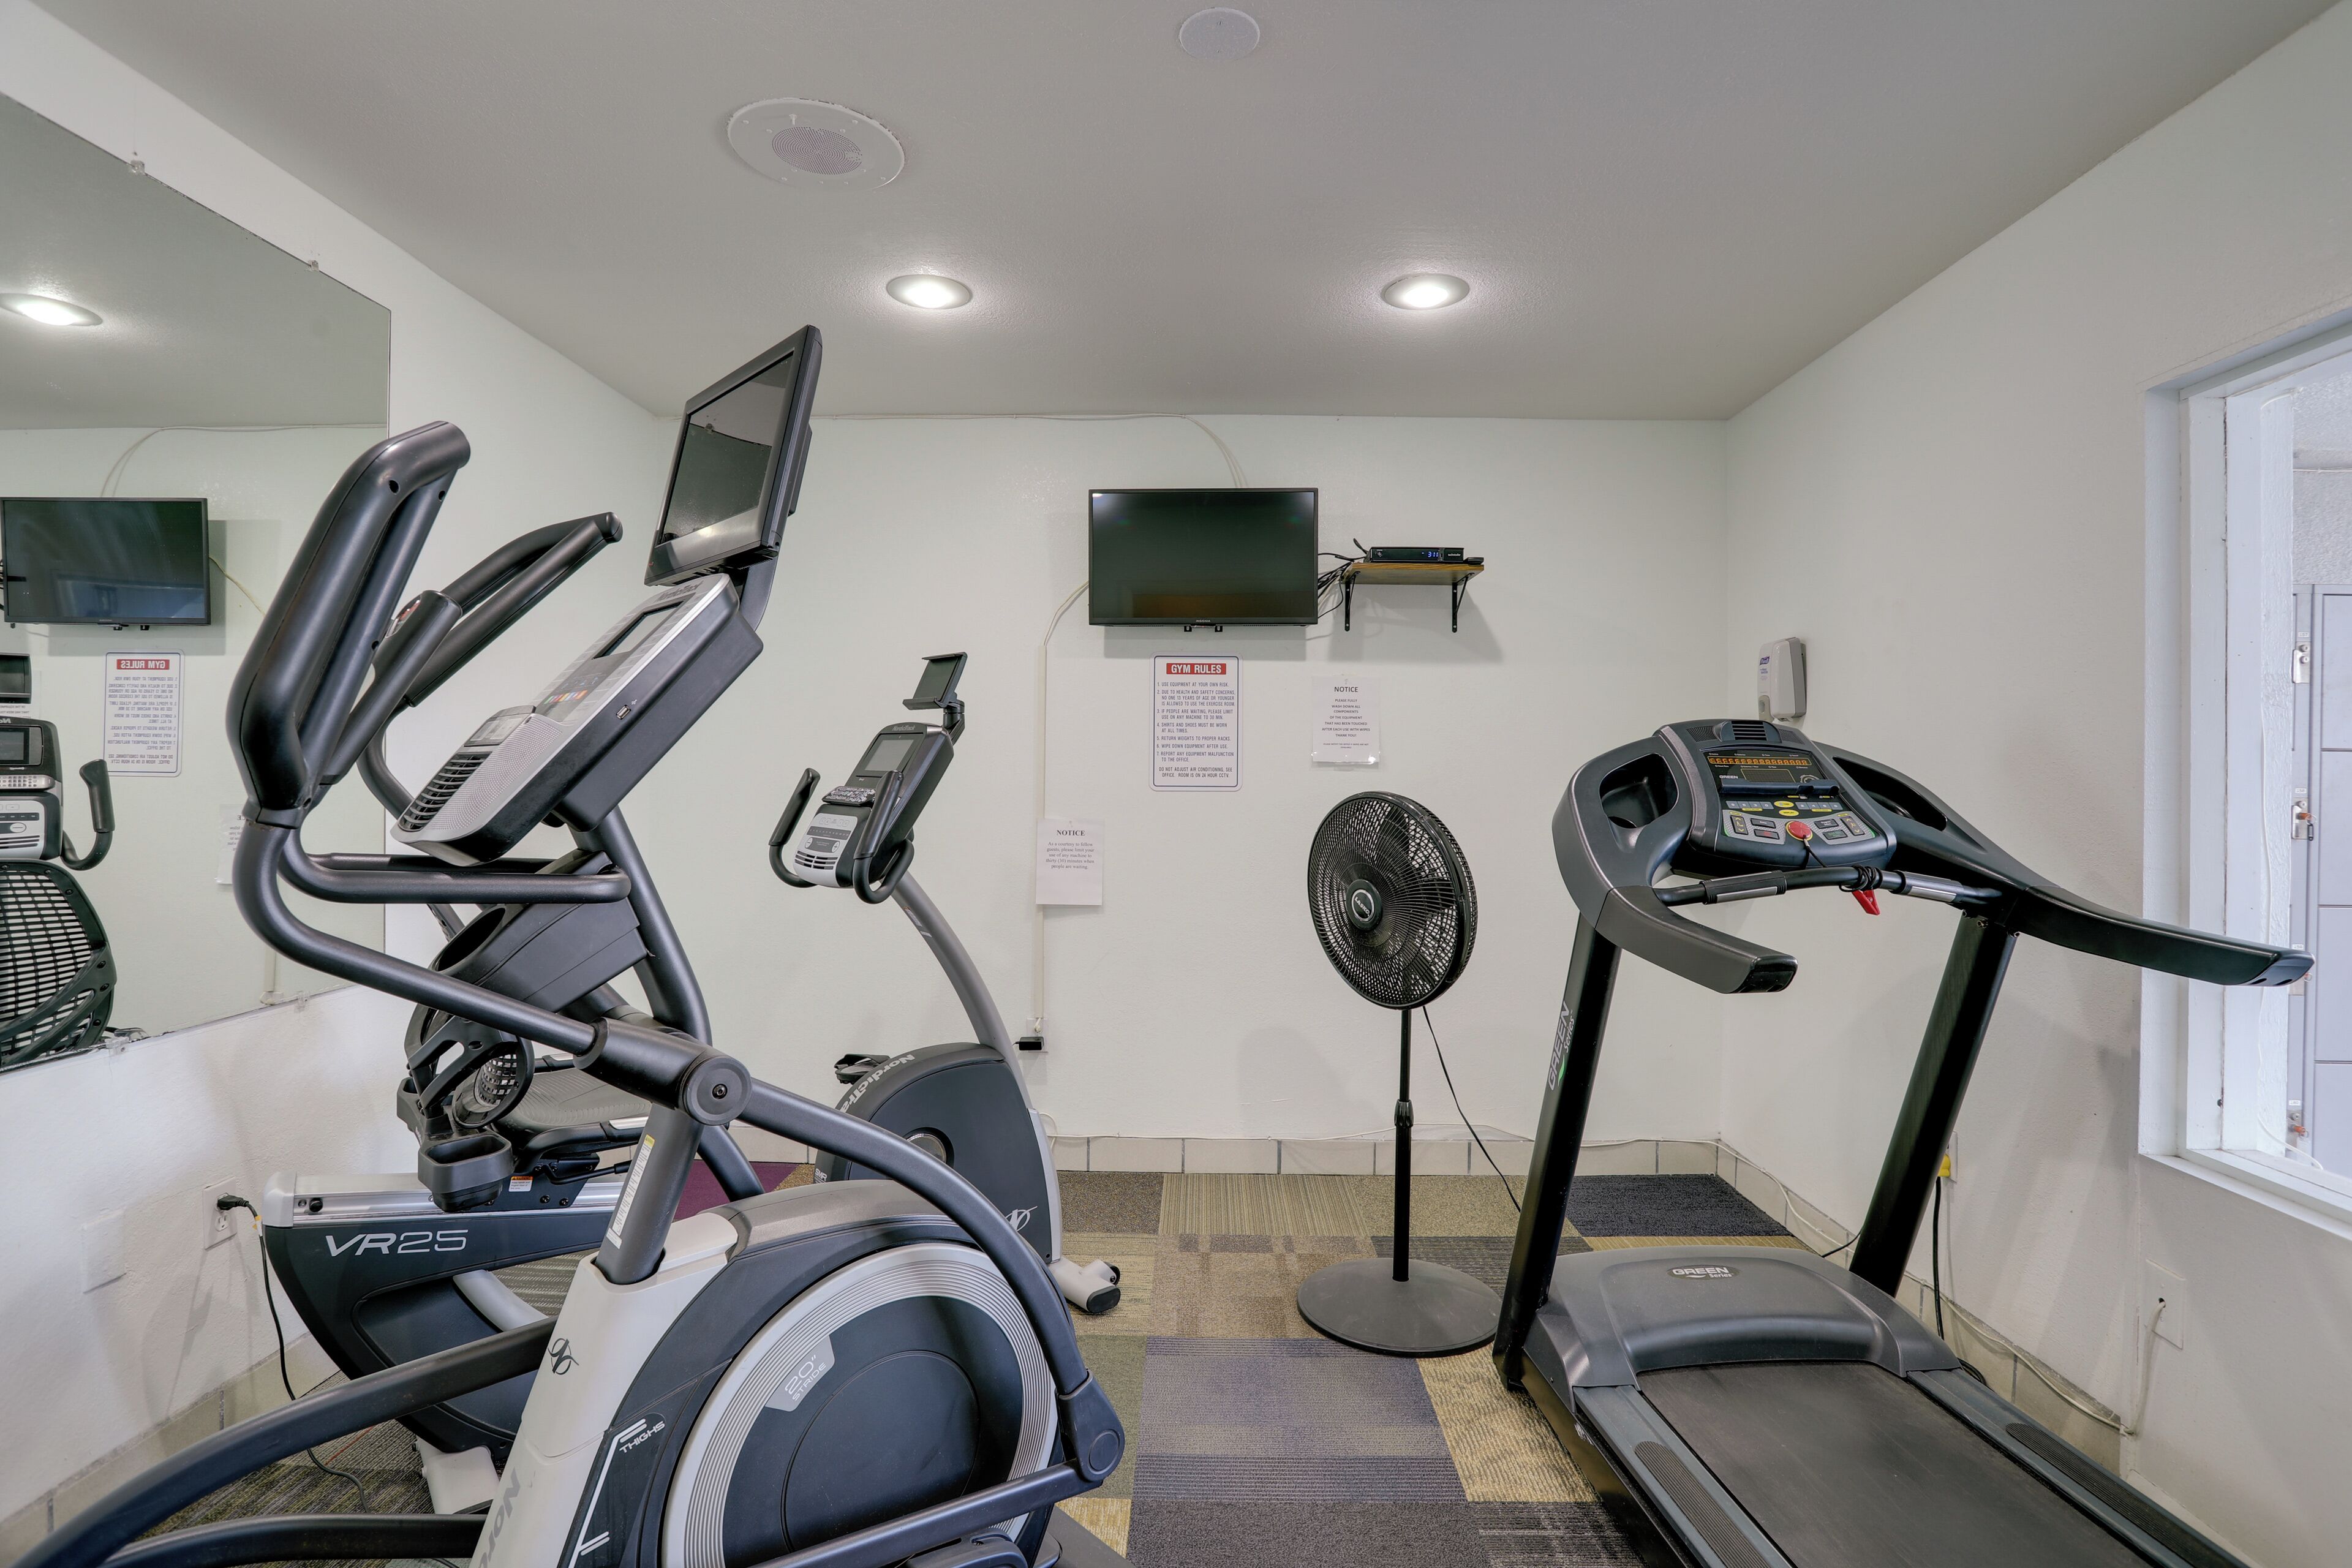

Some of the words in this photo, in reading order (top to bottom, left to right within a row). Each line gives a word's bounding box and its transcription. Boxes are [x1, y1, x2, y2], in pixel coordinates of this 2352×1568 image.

[1171, 664, 1191, 674] GYM
[1194, 664, 1221, 674] RULES
[1355, 896, 1370, 914] LASKO
[1548, 1001, 1570, 1090] GREEN
[1564, 1015, 1575, 1054] Series
[840, 1054, 916, 1113] NordicTra
[815, 1168, 827, 1182] SMR
[325, 1229, 469, 1257] VR25
[792, 1362, 827, 1401] STRIDE
[619, 1421, 665, 1454] THIGHS
